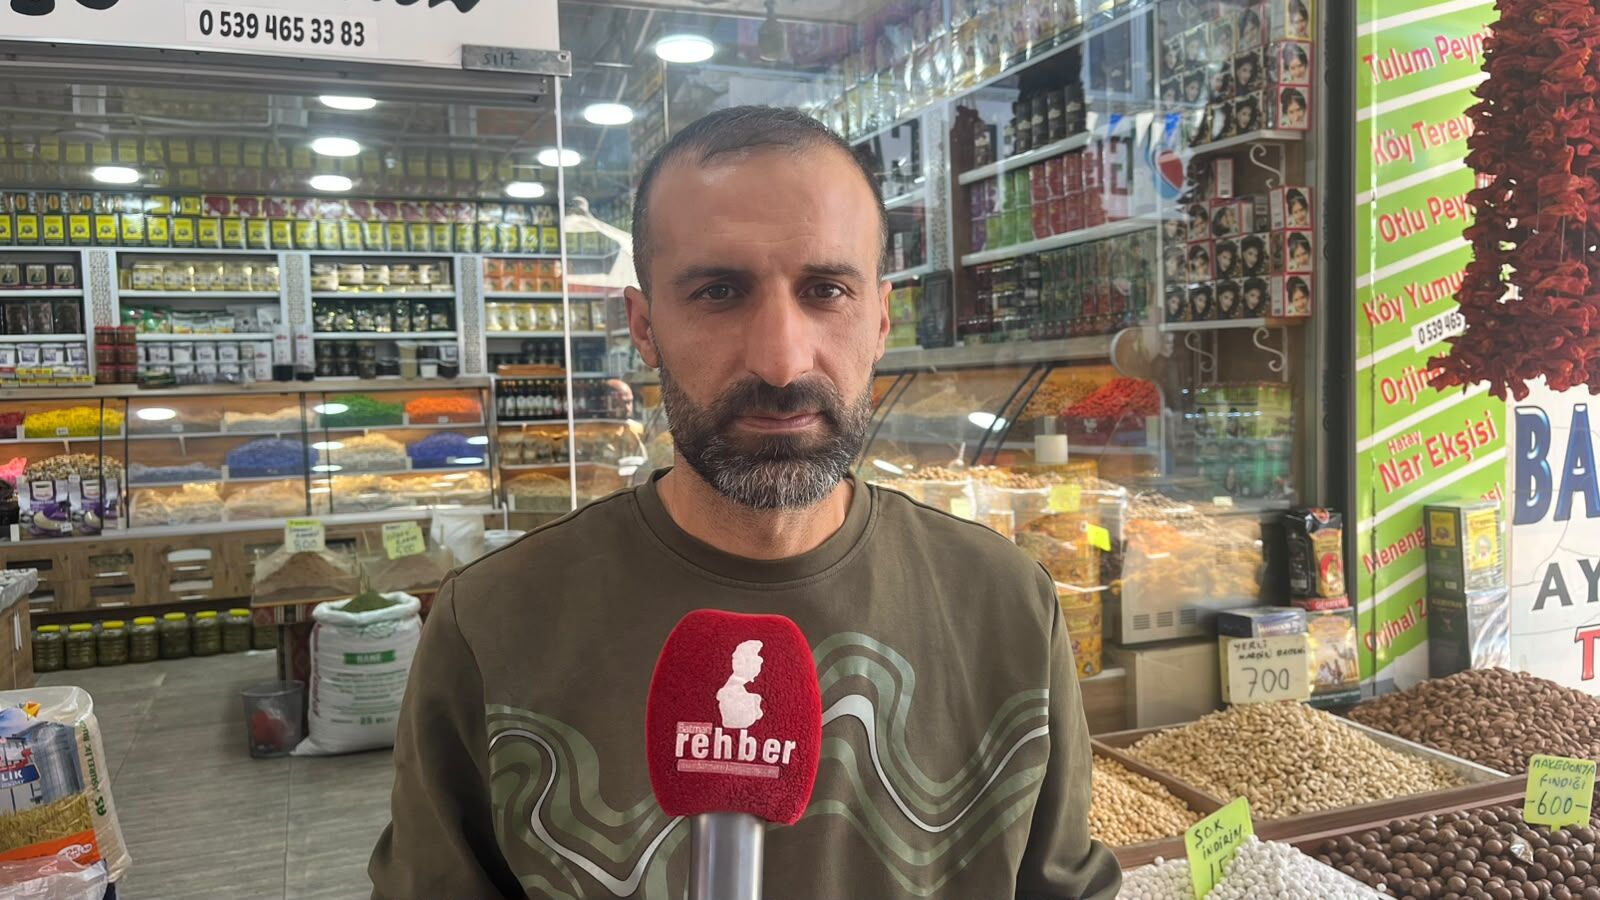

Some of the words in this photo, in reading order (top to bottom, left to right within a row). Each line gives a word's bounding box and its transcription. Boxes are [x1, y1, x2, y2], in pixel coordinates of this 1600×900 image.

[199, 9, 213, 36] 0
[220, 11, 259, 39] 539
[265, 15, 305, 42] 465
[310, 18, 334, 44] 33
[341, 21, 365, 47] 83
[1362, 48, 1436, 84] Tulum
[1369, 128, 1415, 166] Köy
[1378, 207, 1428, 244] Otlu
[1362, 294, 1405, 328] Köy
[1404, 270, 1467, 309] Yumu
[1418, 326, 1426, 345] 0
[1427, 319, 1443, 341] 539
[1444, 311, 1461, 332] 465
[1378, 453, 1423, 493] Nar
[1425, 409, 1499, 468] Ekşisi
[1387, 430, 1422, 456] Hatay
[1241, 667, 1290, 698] 700
[675, 727, 796, 765] rehber
[1533, 759, 1596, 775] MAKEDONYA
